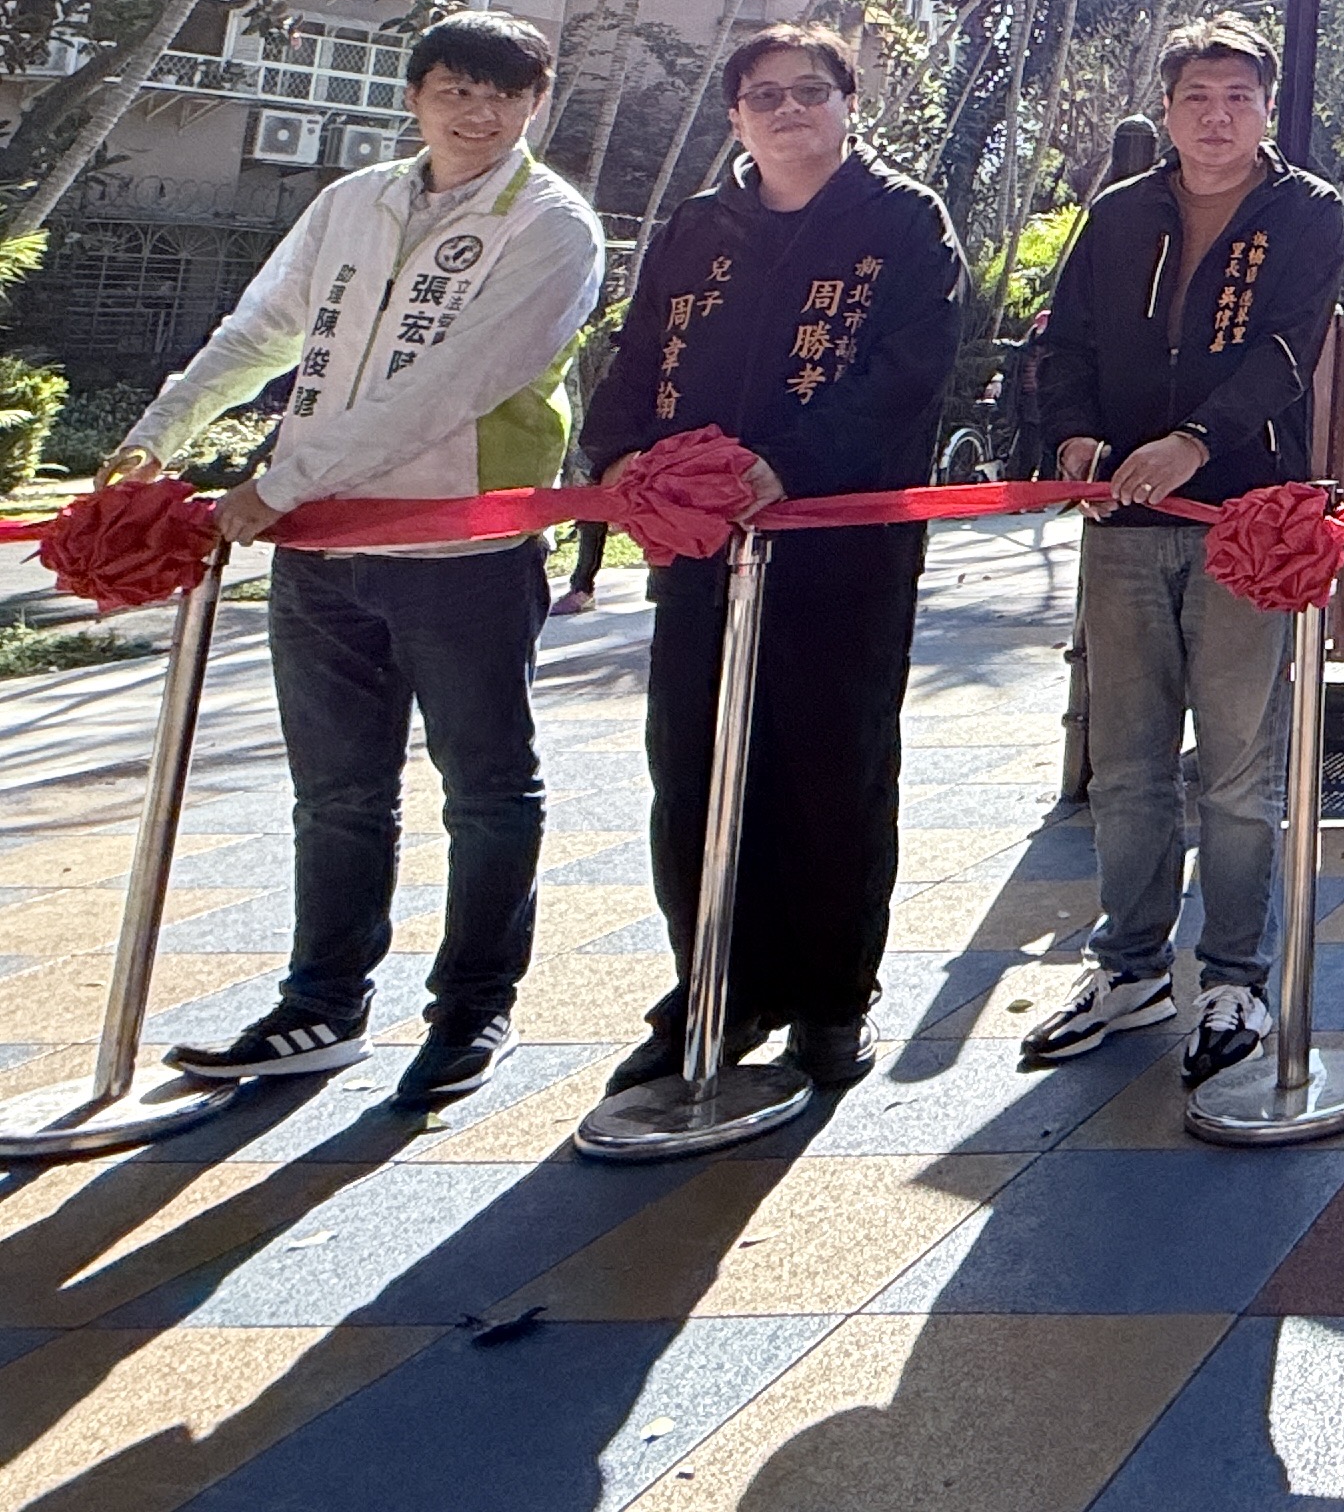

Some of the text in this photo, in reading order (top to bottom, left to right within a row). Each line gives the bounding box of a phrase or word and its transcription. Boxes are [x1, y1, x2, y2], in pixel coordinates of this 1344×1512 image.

[696, 255, 732, 317] 兒子
[786, 279, 845, 405] 周勝考
